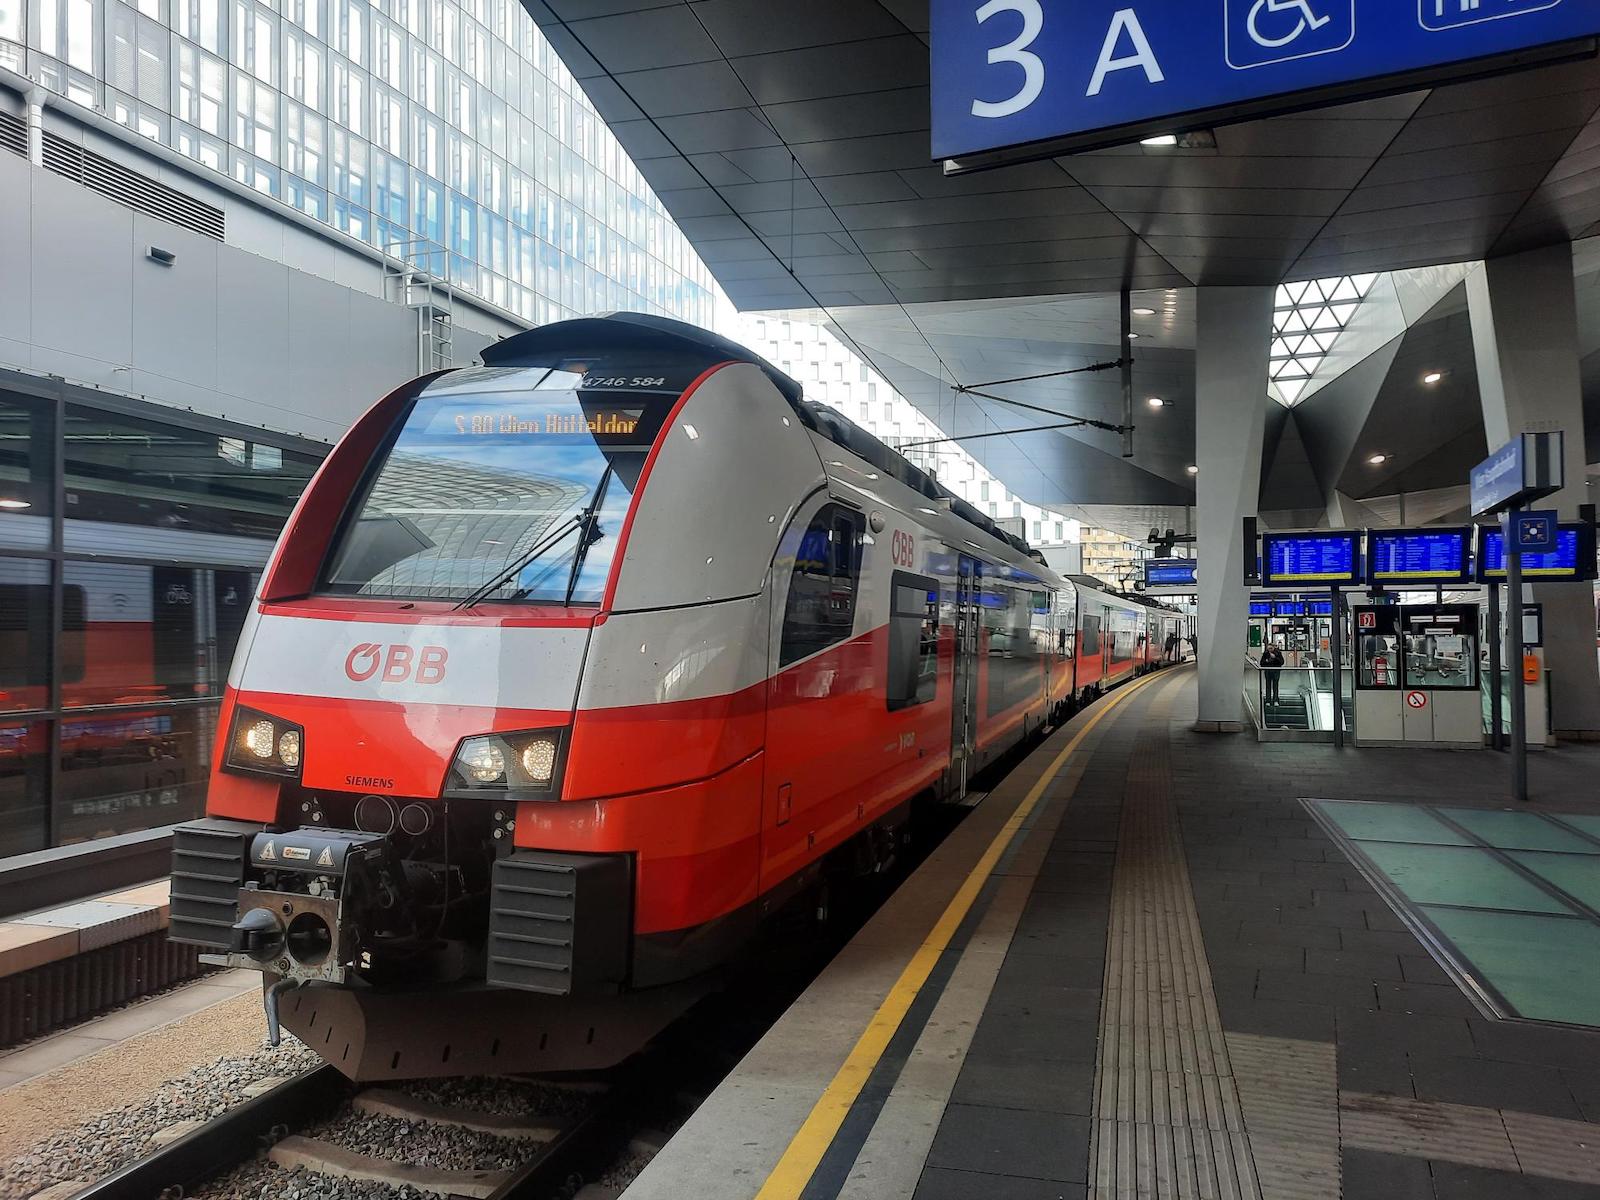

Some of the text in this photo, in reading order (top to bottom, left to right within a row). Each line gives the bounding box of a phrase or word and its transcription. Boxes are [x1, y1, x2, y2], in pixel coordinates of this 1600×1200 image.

[970, 0, 1165, 118] 3 A
[583, 377, 665, 387] 4746 584
[891, 528, 914, 568] ÖBB
[344, 642, 449, 685] ÖBB
[344, 775, 394, 789] SIEMENS
